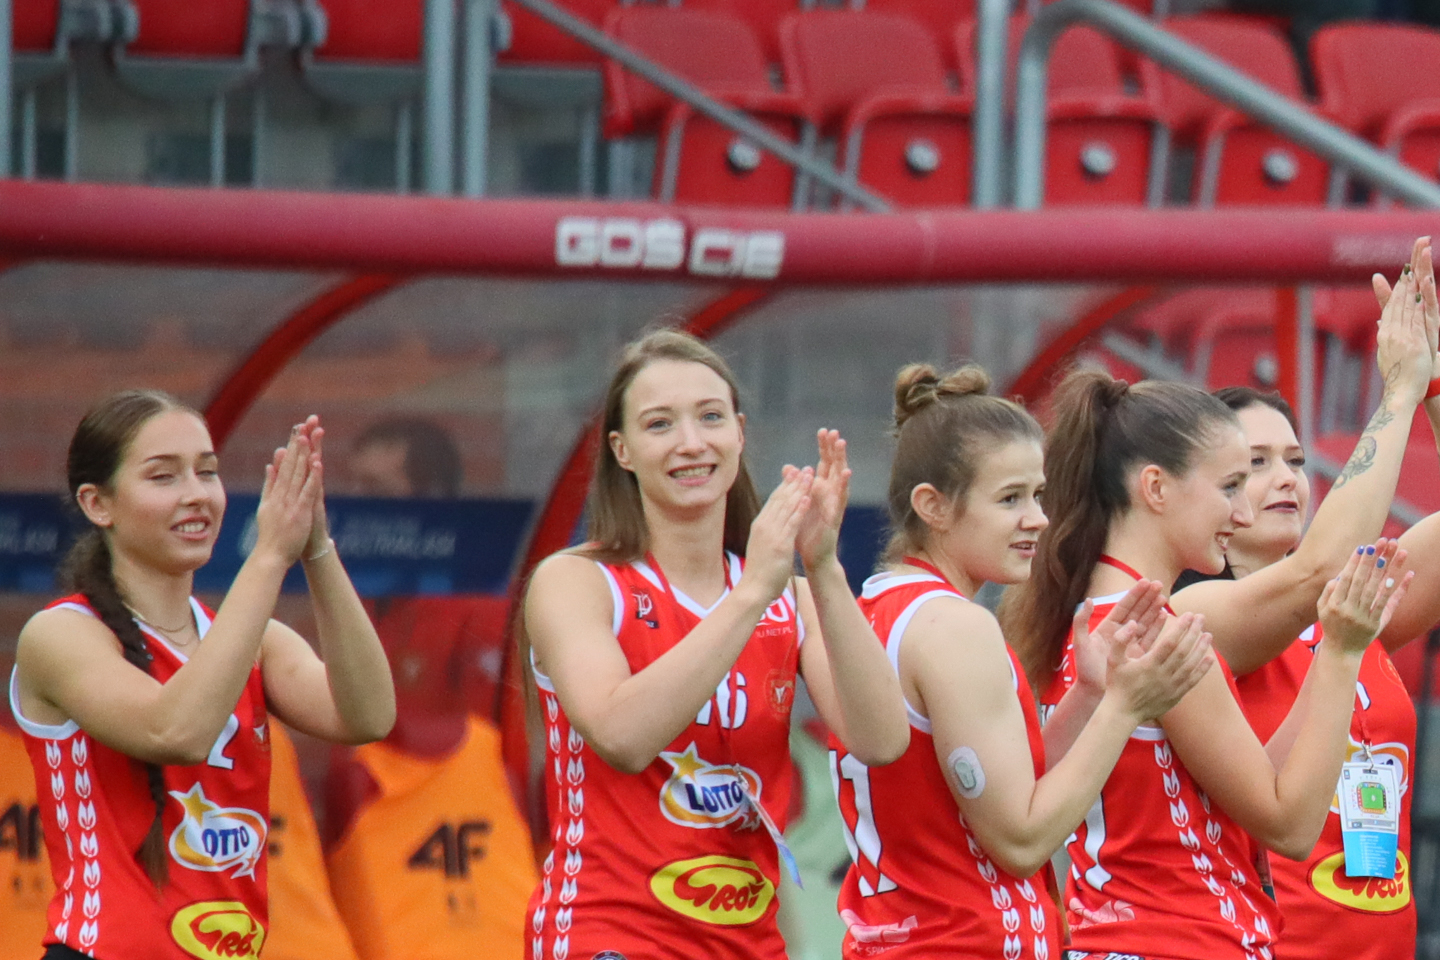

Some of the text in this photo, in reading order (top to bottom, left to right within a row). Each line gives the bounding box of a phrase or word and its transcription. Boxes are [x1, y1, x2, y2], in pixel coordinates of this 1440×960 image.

[685, 780, 743, 813] LOTTO
[202, 825, 251, 859] OTTO
[407, 822, 490, 878] 4F
